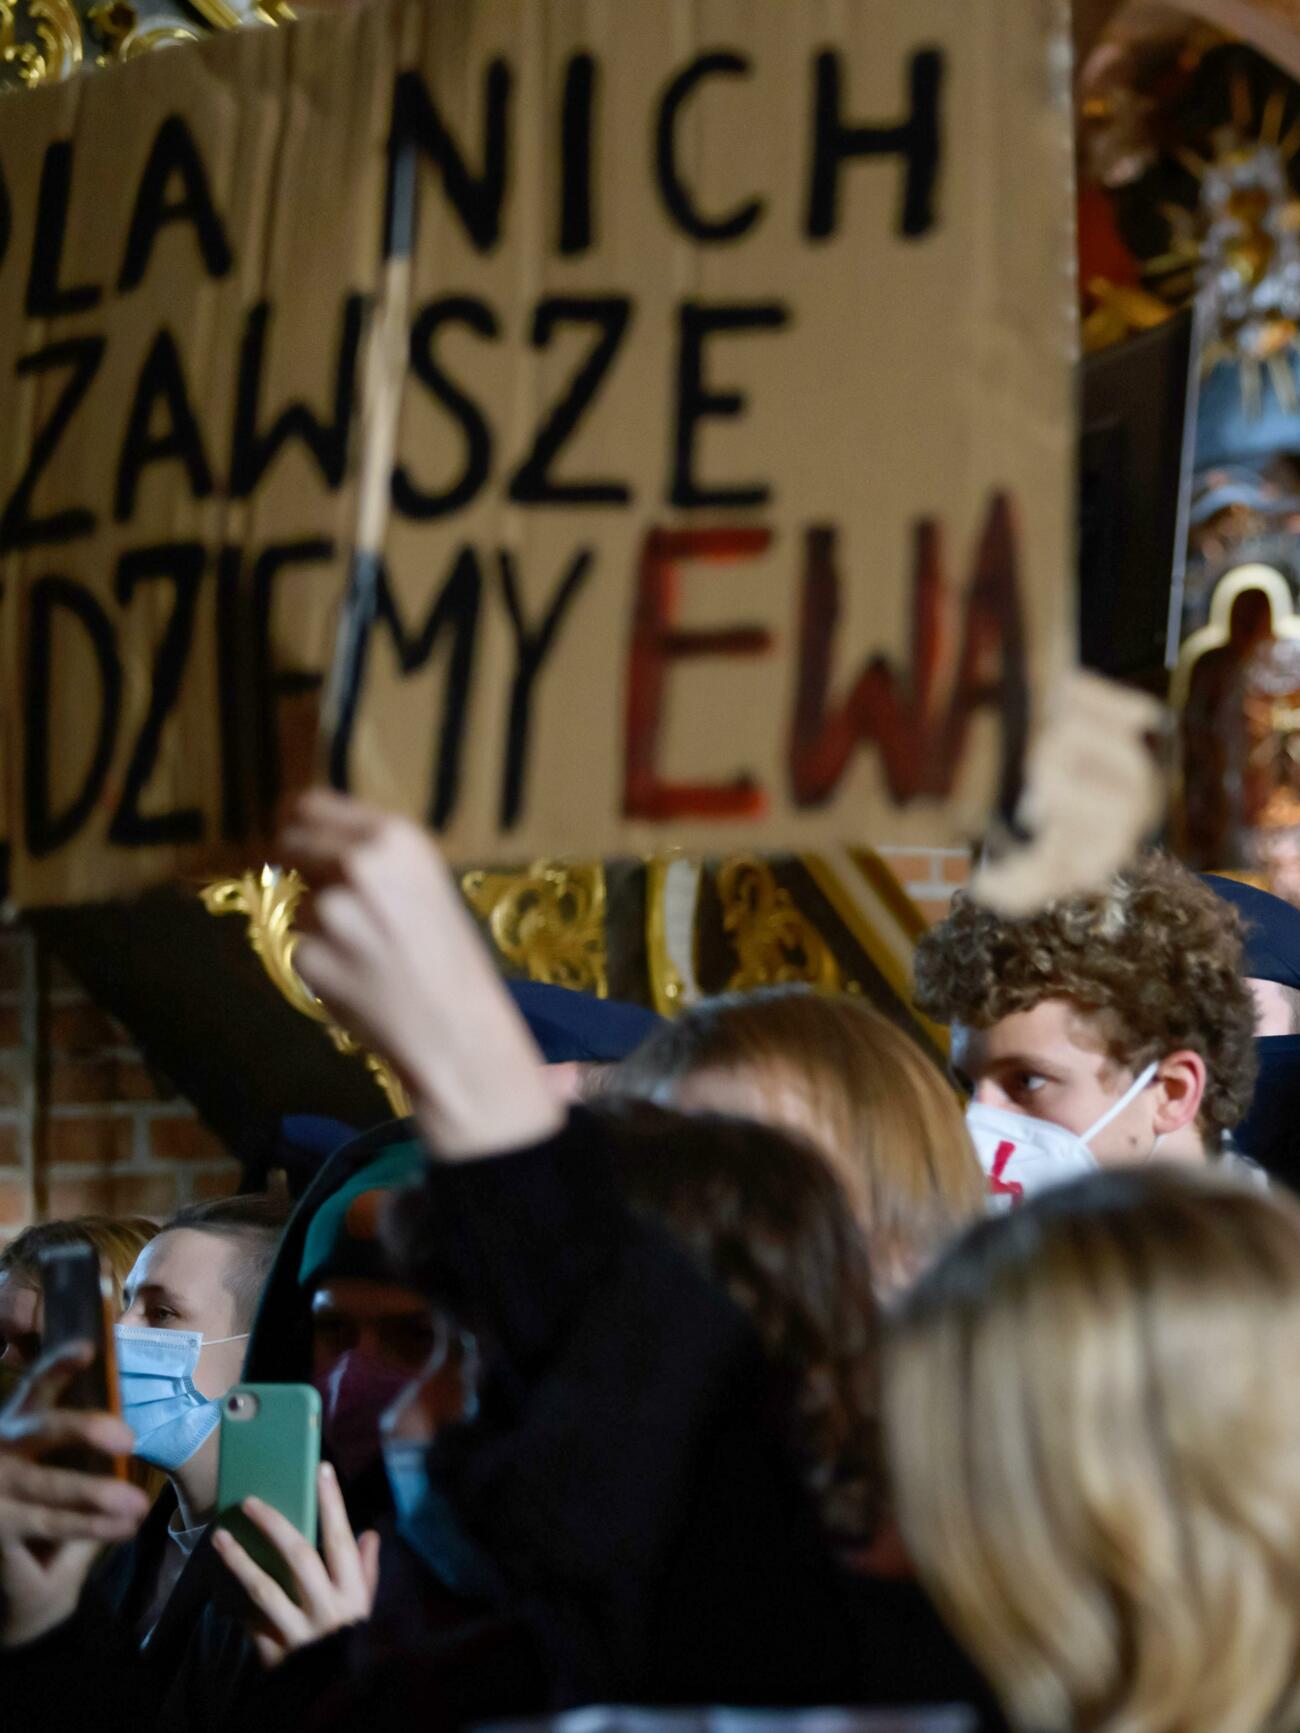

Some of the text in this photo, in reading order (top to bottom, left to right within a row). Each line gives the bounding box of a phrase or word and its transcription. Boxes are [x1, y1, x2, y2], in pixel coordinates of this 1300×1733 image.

[0, 46, 943, 320] LA NICH
[0, 290, 793, 548] ZAWSZE
[0, 542, 594, 860] DZIEMY
